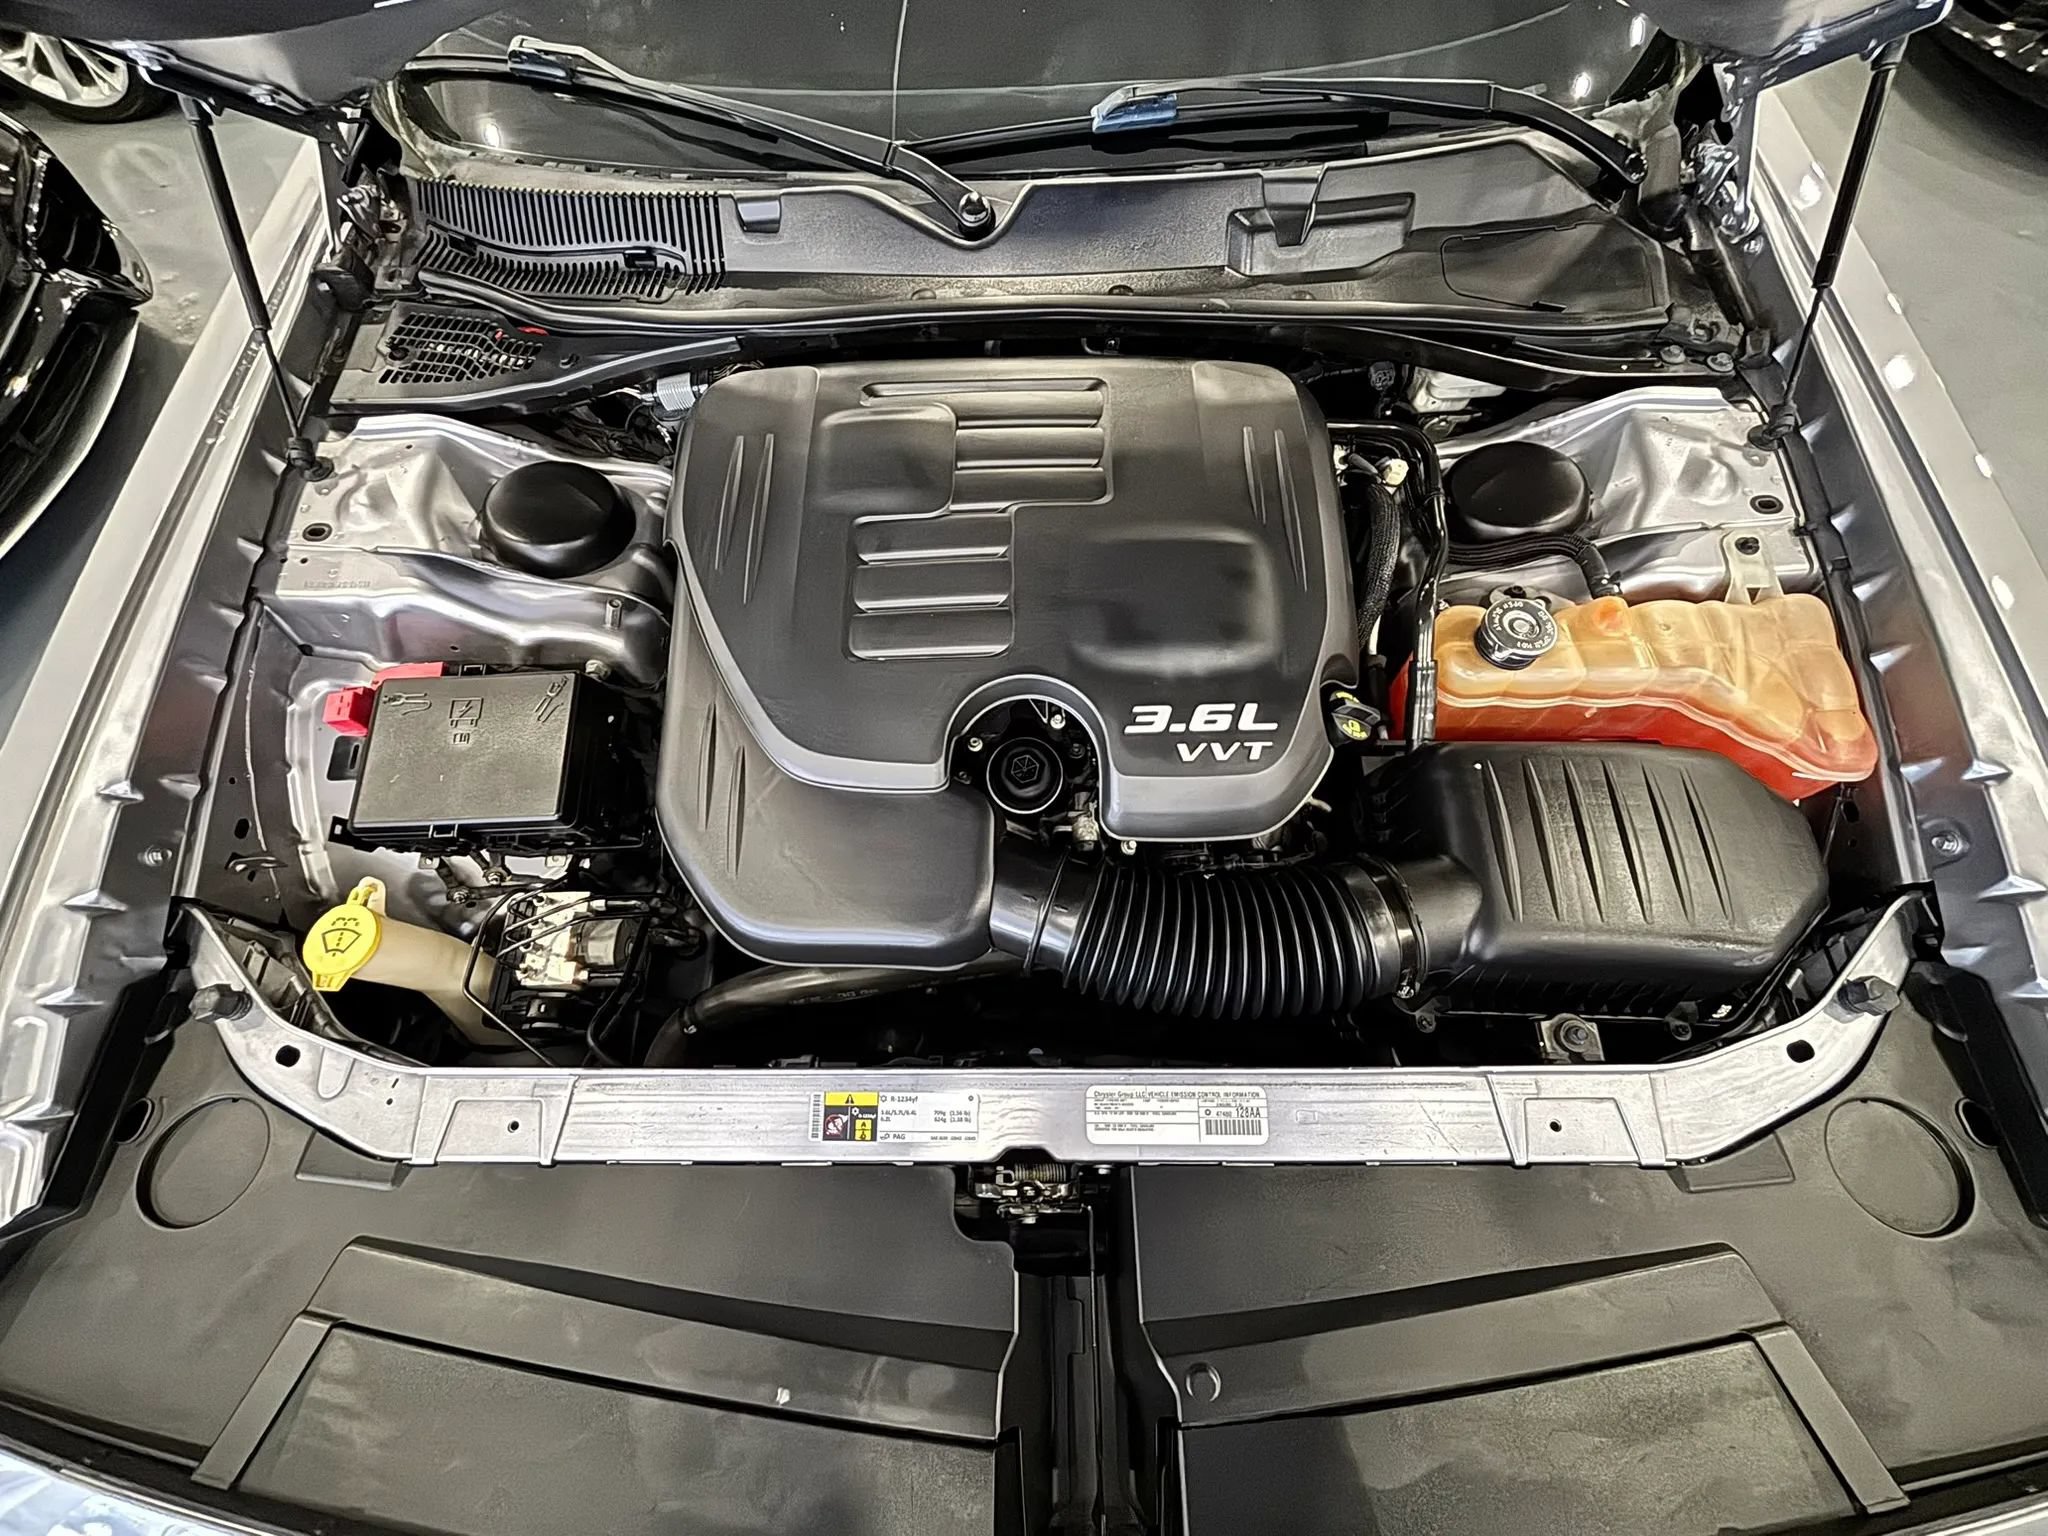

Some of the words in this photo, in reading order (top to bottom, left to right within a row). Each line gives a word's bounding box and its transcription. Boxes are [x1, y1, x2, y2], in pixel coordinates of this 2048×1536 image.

[1124, 703, 1278, 735] 3.6L
[1176, 741, 1273, 762] VVT
[1094, 1090, 1116, 1099] Chrysler
[1235, 1106, 1261, 1118] 128AA
